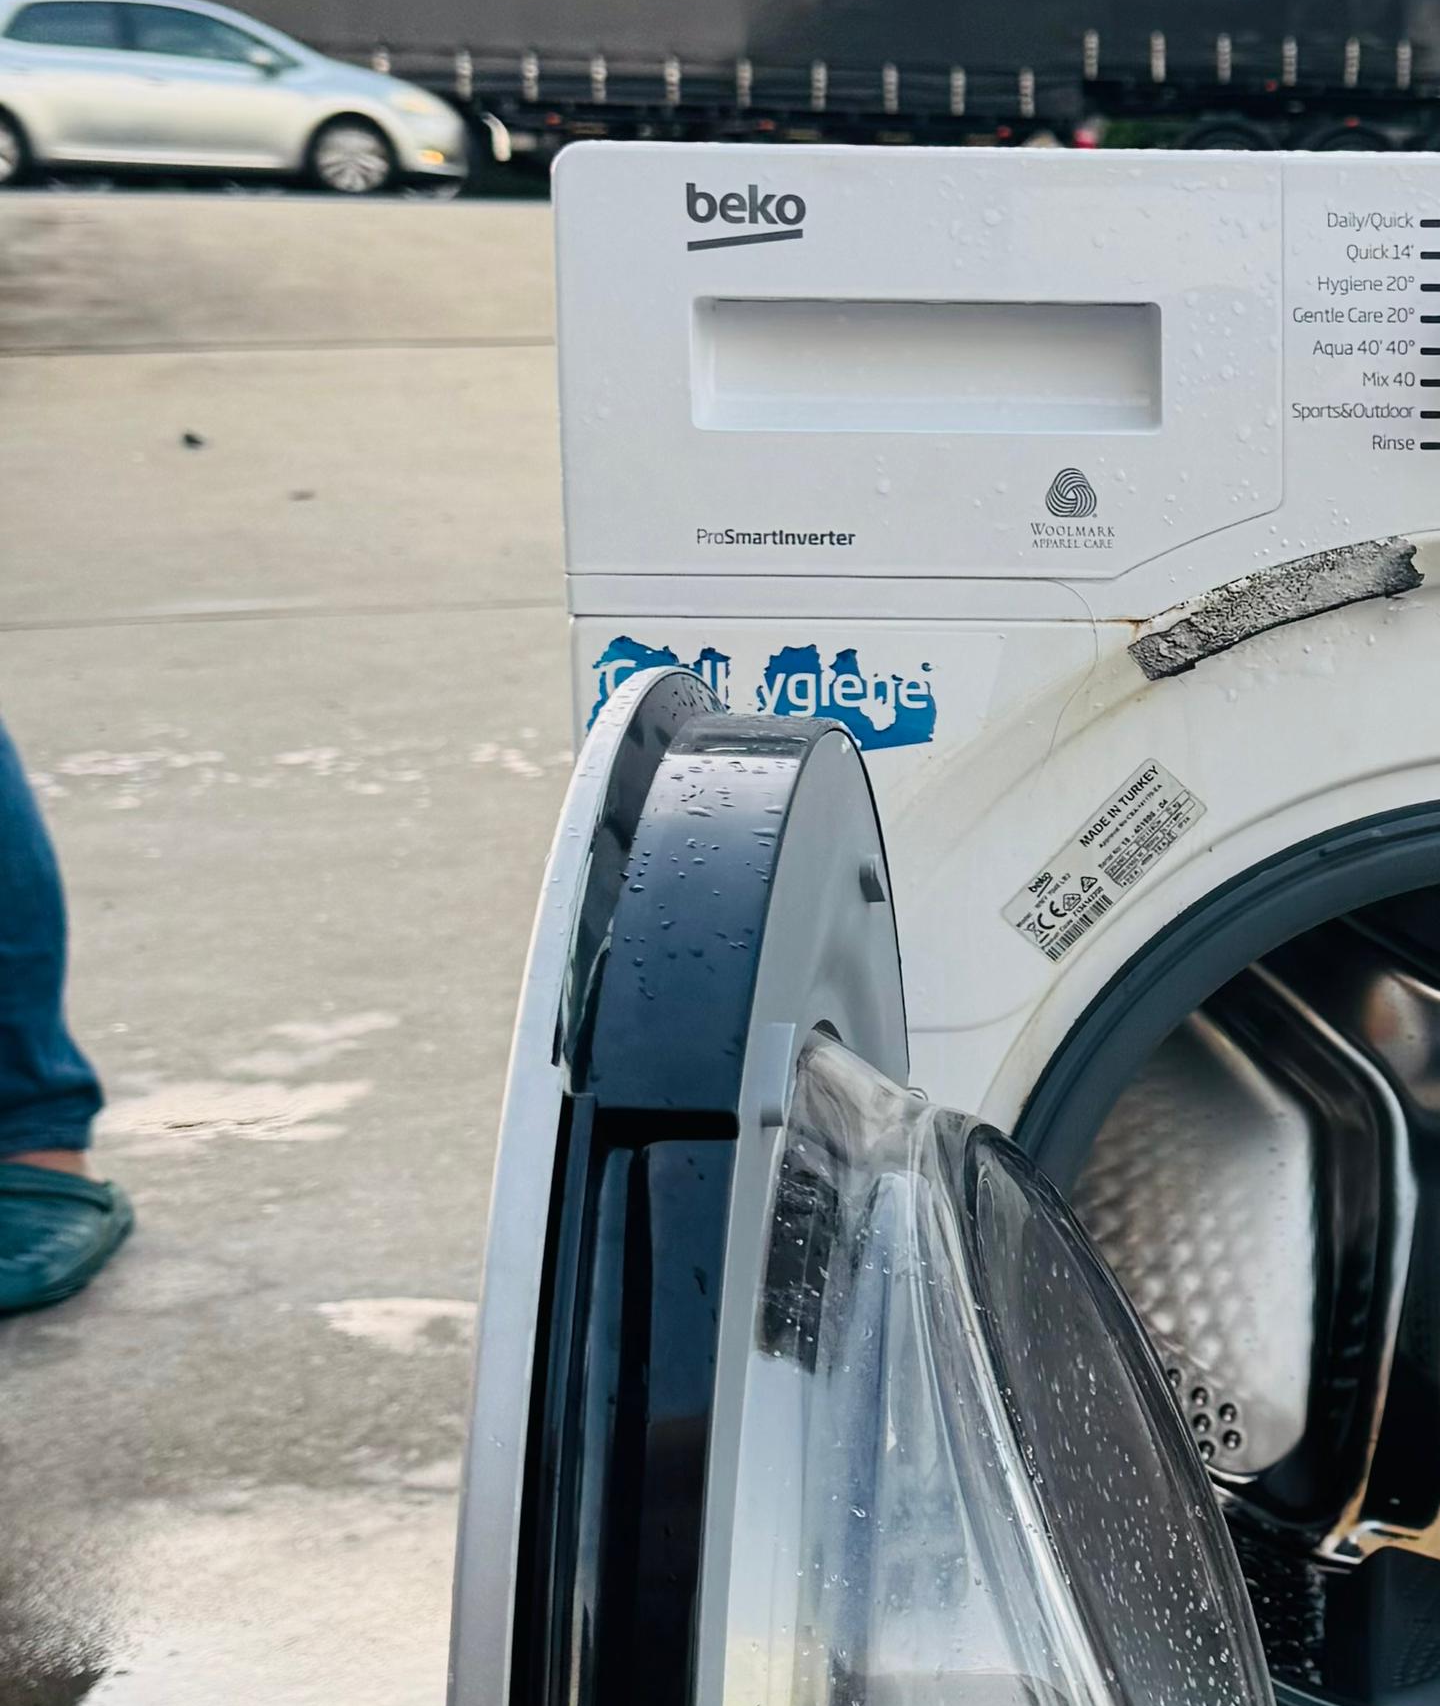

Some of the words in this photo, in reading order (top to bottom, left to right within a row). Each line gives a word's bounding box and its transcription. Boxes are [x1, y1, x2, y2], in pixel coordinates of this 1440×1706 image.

[686, 183, 806, 225] beko
[1328, 212, 1413, 232] Daily/Quick
[1347, 244, 1388, 263] Quick
[1318, 276, 1383, 295] Hygiene
[1293, 307, 1344, 323] Gentle
[1347, 308, 1383, 323] Care
[1313, 341, 1353, 358] Aqua
[1363, 373, 1389, 386] Mix
[1393, 372, 1415, 387] 40
[1292, 403, 1414, 421] Sports&Outdoor
[1373, 435, 1415, 450] Rinse
[697, 529, 856, 545] ProSmartInverter
[1032, 539, 1080, 549] APPAREL
[1084, 539, 1114, 549] CARE
[1080, 816, 1111, 847] MADE
[1107, 805, 1121, 818] IN
[1118, 765, 1159, 806] TURKEY
[1028, 872, 1051, 893] beko
